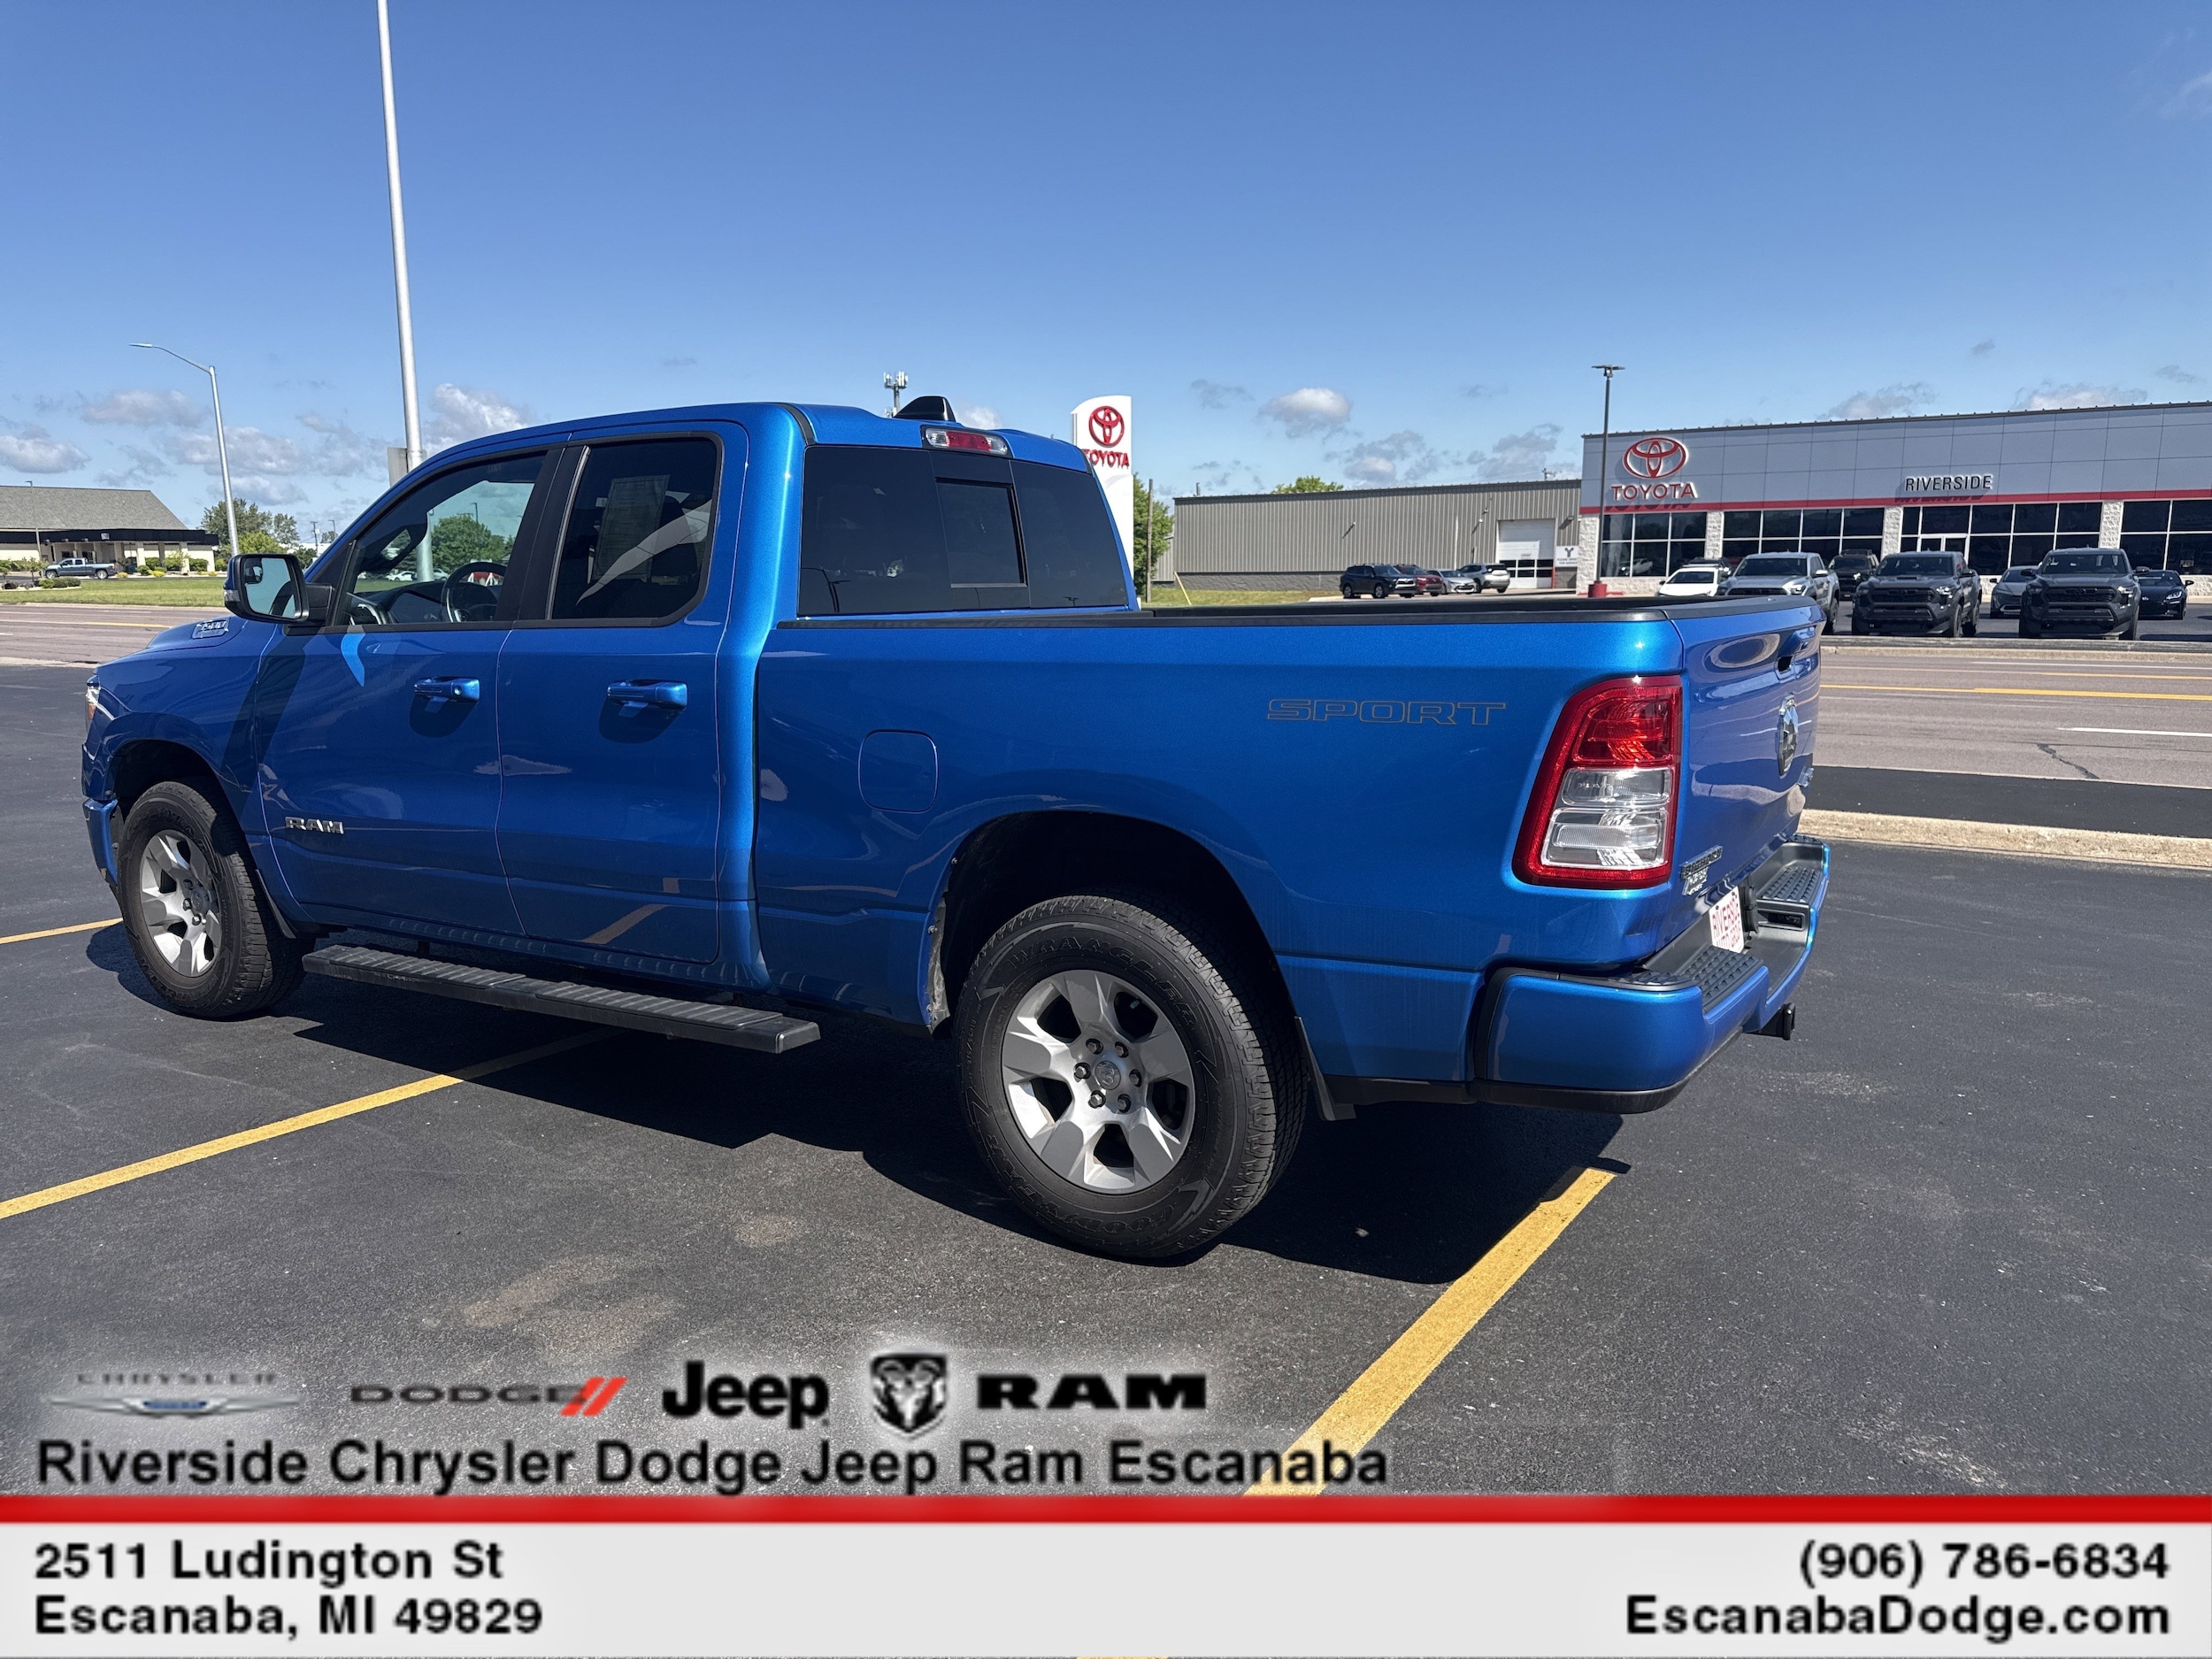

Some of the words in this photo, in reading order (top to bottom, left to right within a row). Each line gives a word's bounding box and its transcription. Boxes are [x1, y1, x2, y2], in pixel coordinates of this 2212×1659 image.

[1082, 449, 1130, 469] TOYOTA
[1610, 482, 1698, 501] TOYOTA
[1905, 475, 1993, 492] RIVERSIDE
[1267, 698, 1506, 726] SPORT
[285, 816, 344, 834] RAM
[1006, 935, 1198, 1026] WRANGLER
[987, 1133, 1174, 1234] GOODYEAR
